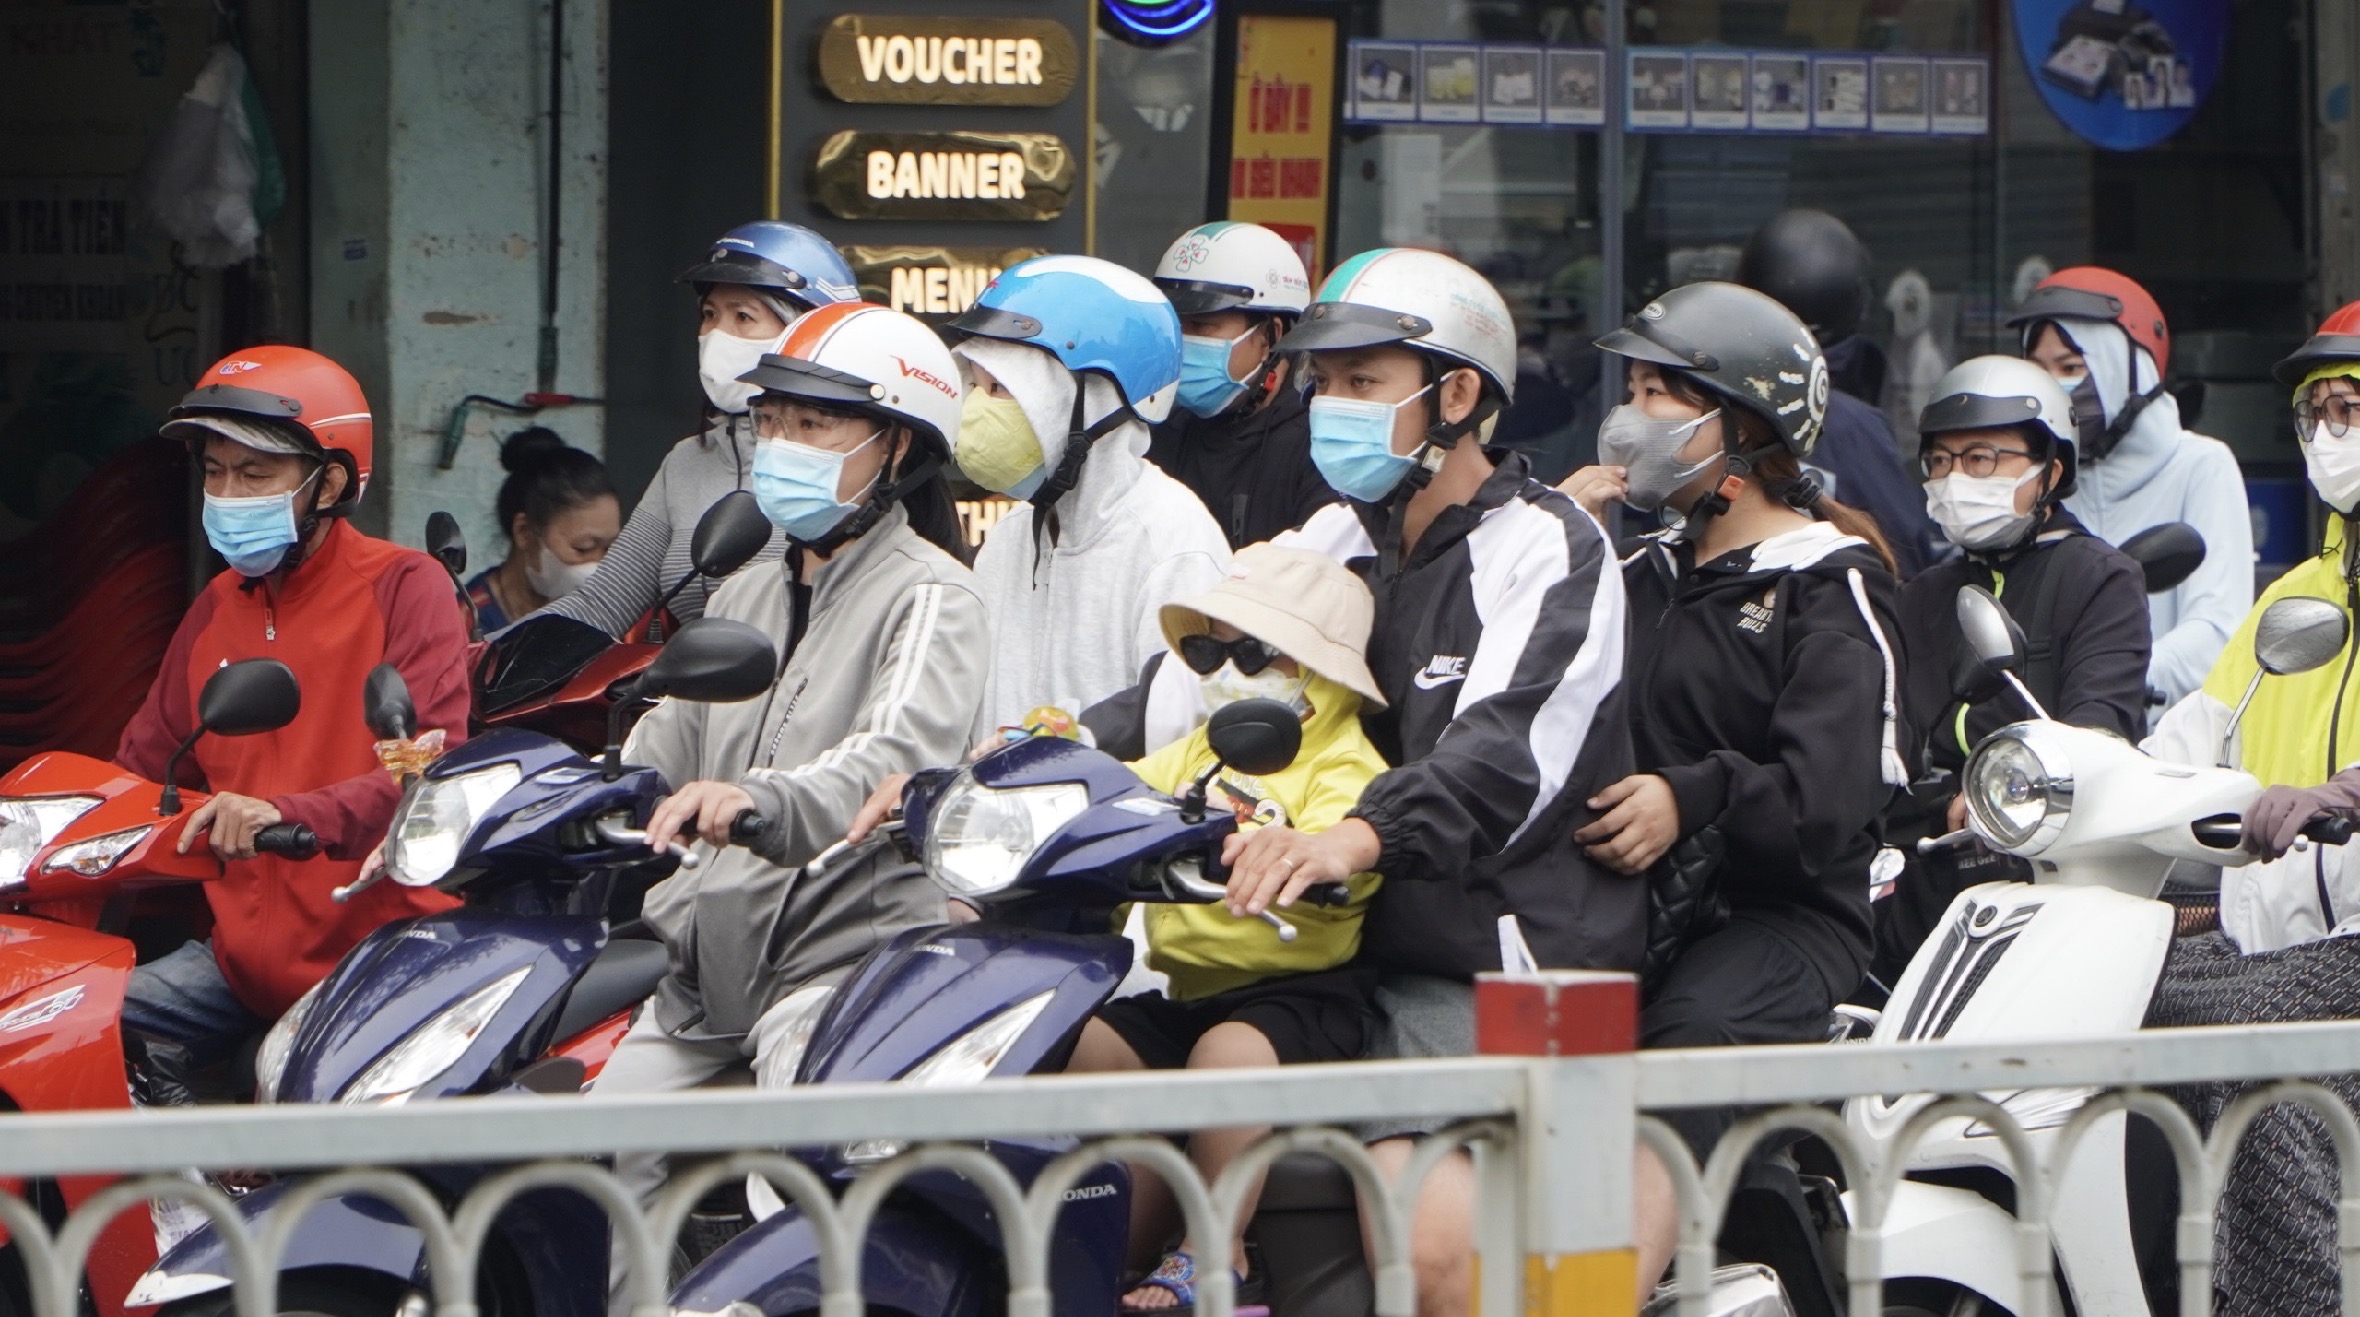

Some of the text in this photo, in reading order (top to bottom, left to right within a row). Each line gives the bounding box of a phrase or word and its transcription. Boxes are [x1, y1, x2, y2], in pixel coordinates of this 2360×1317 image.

[856, 35, 1043, 85] VOUCHER
[867, 151, 1026, 200] BANNER
[889, 354, 959, 400] VISION
[1425, 654, 1466, 675] NIKE
[914, 943, 956, 956] ONDA
[1062, 1184, 1117, 1201] ONDA
